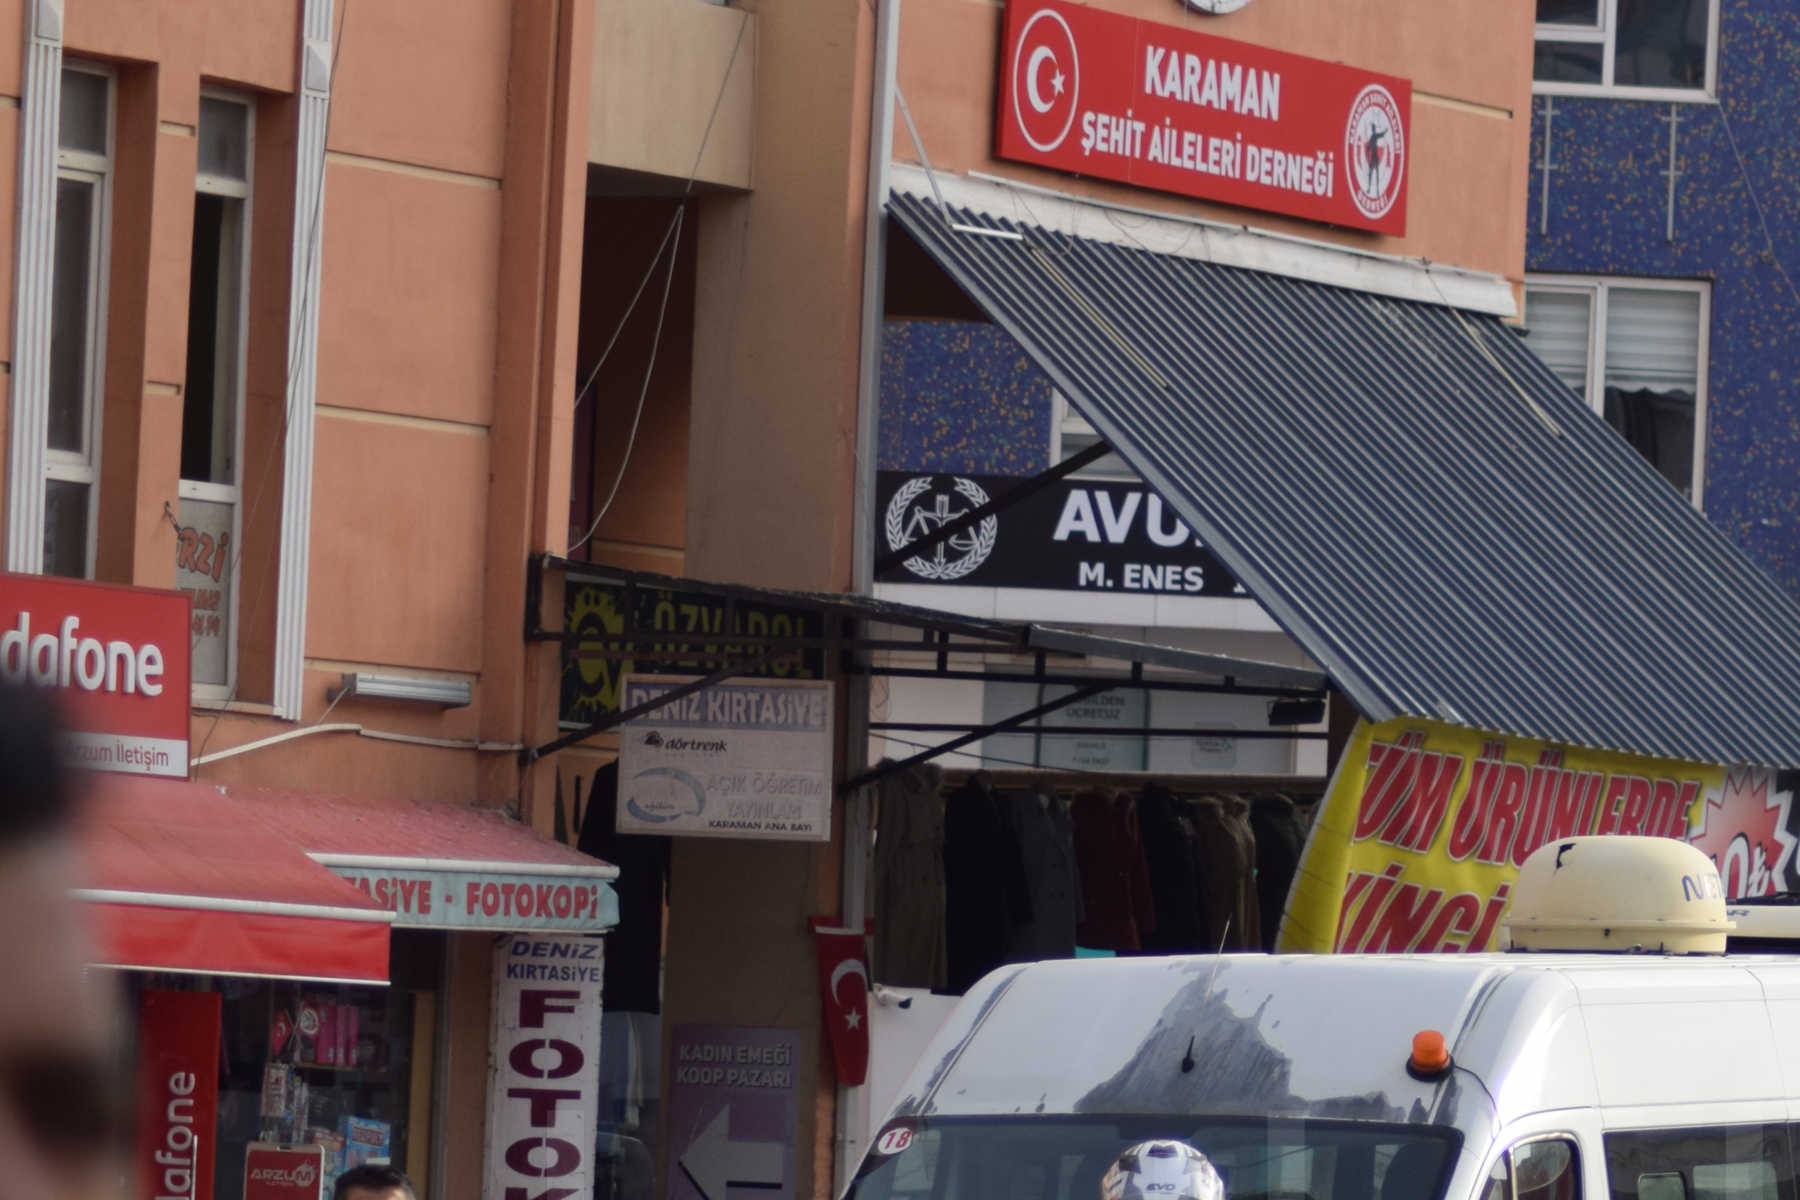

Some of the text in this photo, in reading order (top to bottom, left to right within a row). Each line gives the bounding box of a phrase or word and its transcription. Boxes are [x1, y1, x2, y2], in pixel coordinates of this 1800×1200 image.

[1144, 44, 1281, 121] KARAMAN
[1081, 108, 1335, 198] ŞEHİT AİLELERİ DERNEĞİ
[1052, 488, 1204, 548] AVU
[1078, 561, 1114, 589] M.
[1123, 563, 1205, 592] ENES
[116, 738, 170, 772] İletişim
[679, 1041, 792, 1066] KADIN EMEĞİ
[676, 1068, 793, 1089] KOOP PAZARI
[884, 1130, 912, 1149] 18
